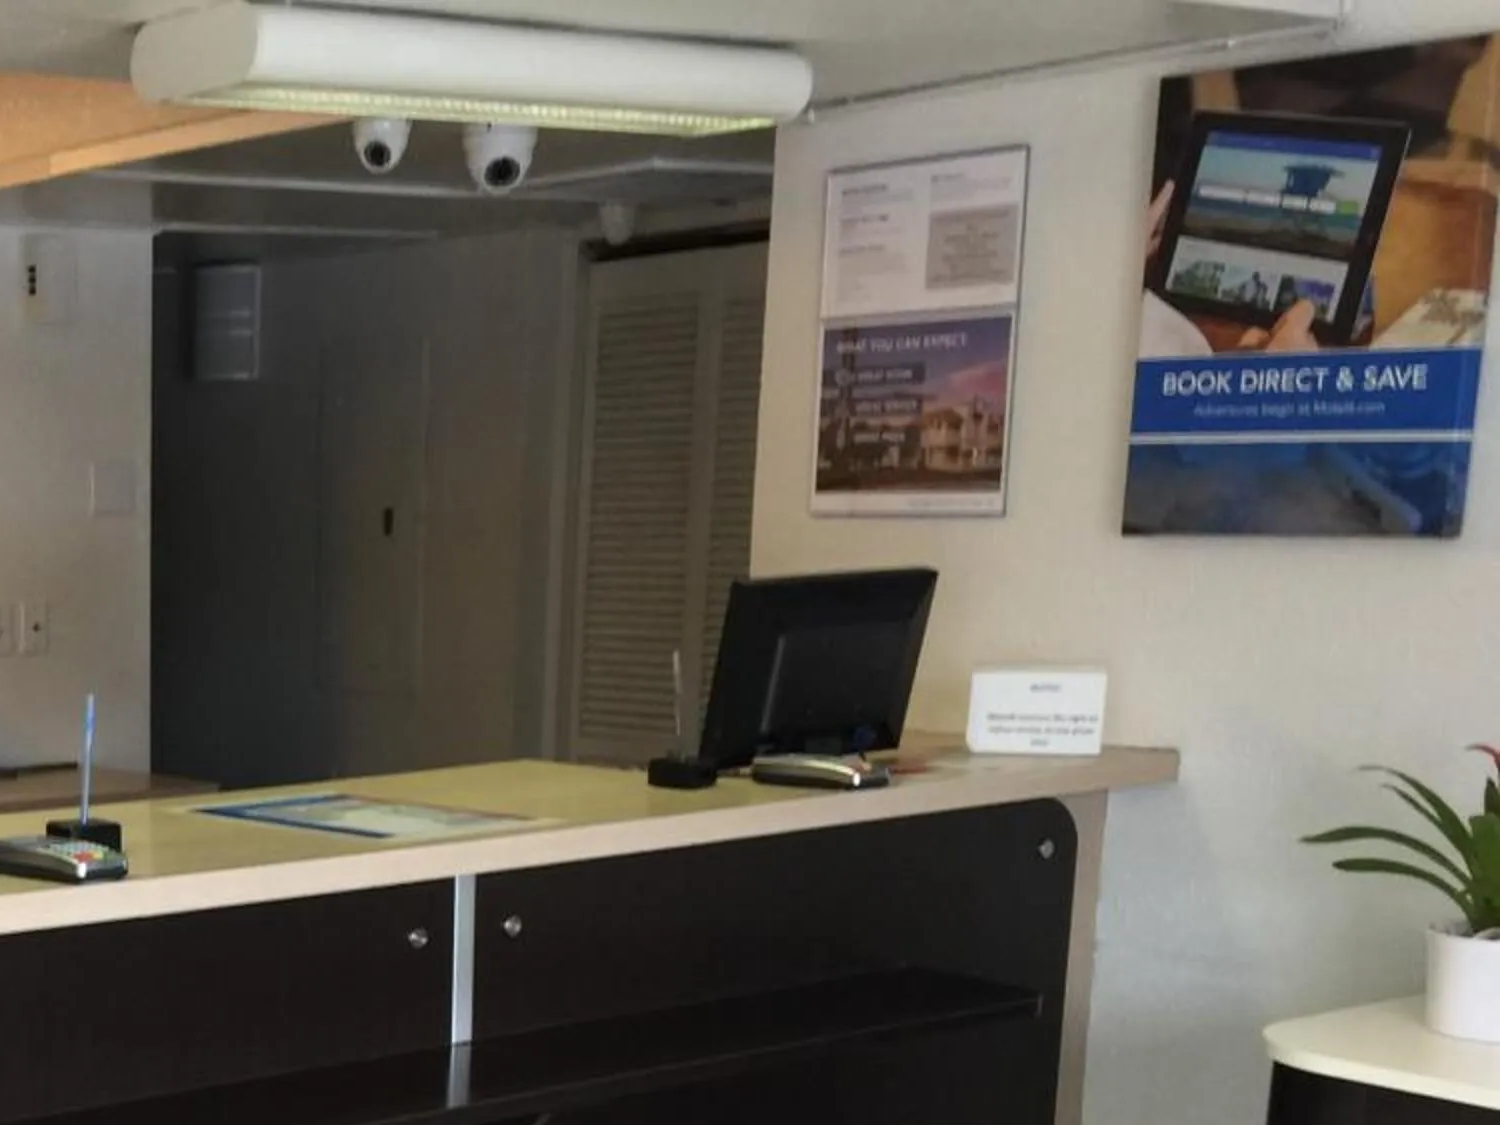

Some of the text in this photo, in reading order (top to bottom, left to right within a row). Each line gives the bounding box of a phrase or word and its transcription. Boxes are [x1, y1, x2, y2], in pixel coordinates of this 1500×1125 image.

[1162, 363, 1429, 397] BOOK DIRECT & SAVE
